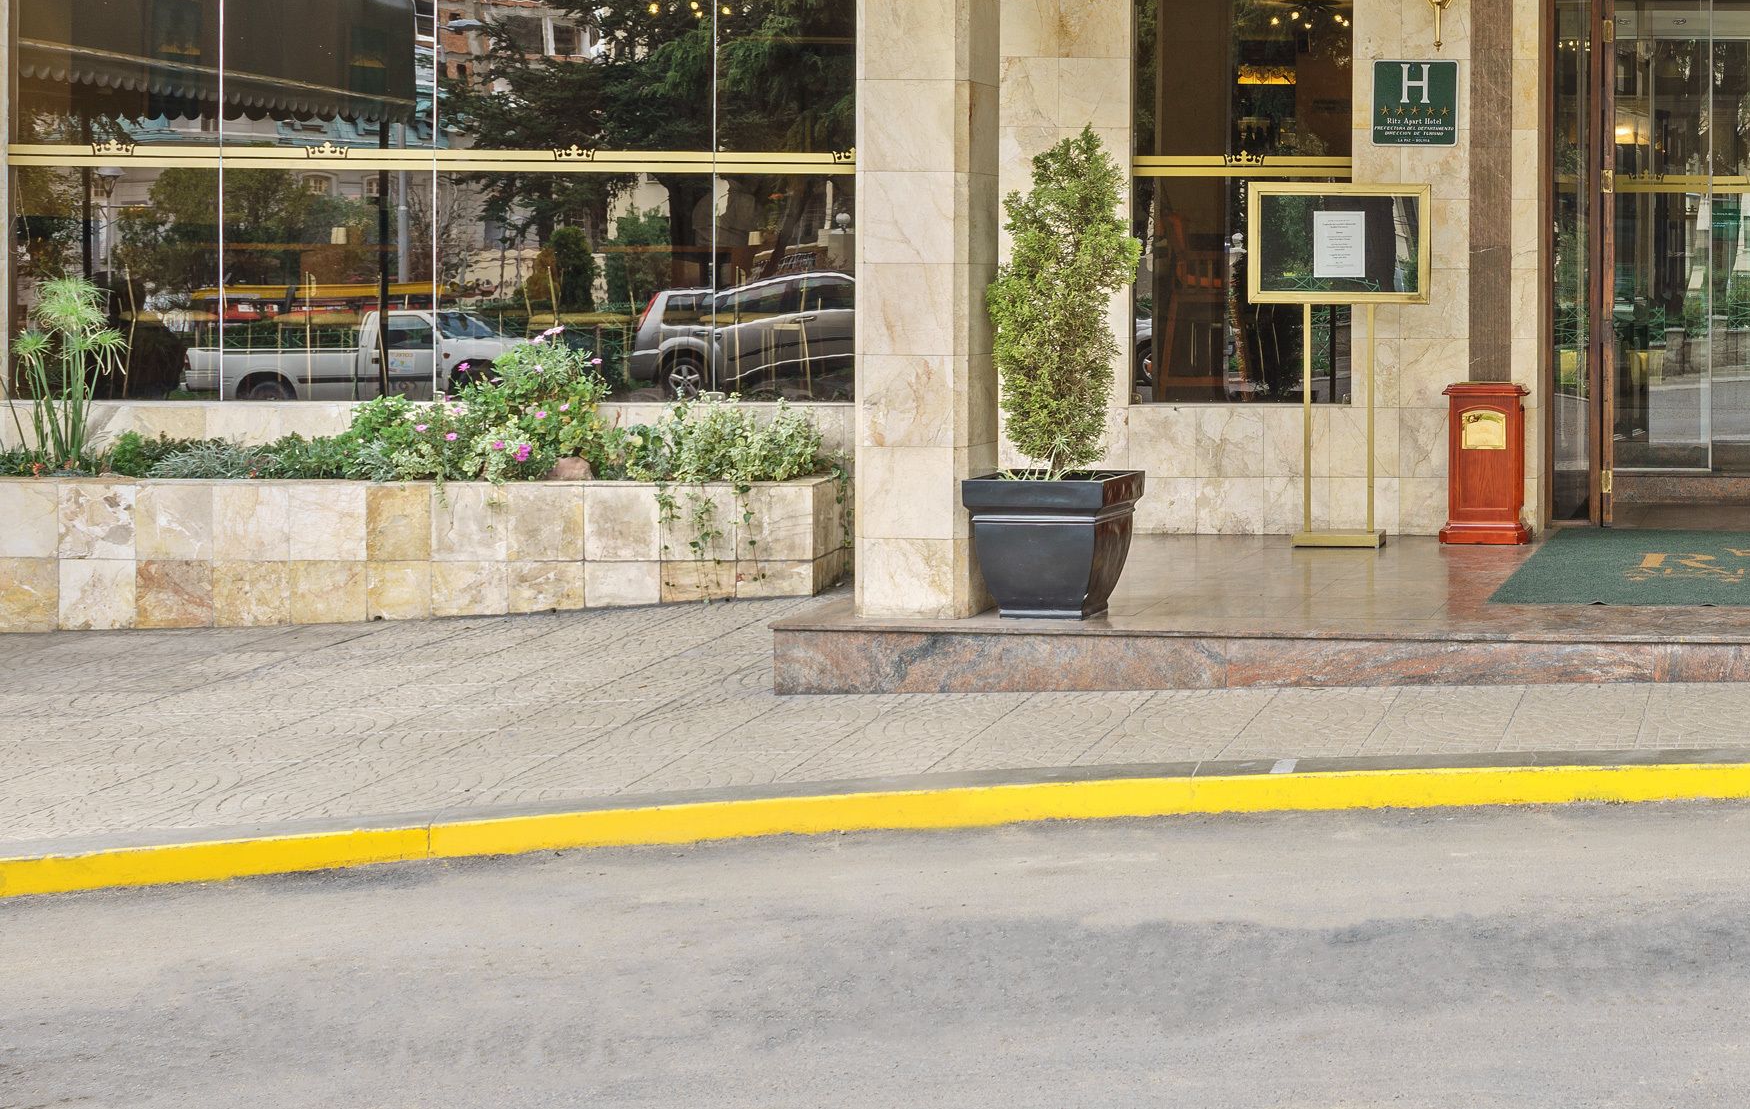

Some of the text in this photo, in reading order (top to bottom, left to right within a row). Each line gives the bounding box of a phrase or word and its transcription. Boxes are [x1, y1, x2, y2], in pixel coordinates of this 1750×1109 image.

[1399, 63, 1431, 104] H
[1386, 117, 1442, 126] Ritz Apart Hotel
